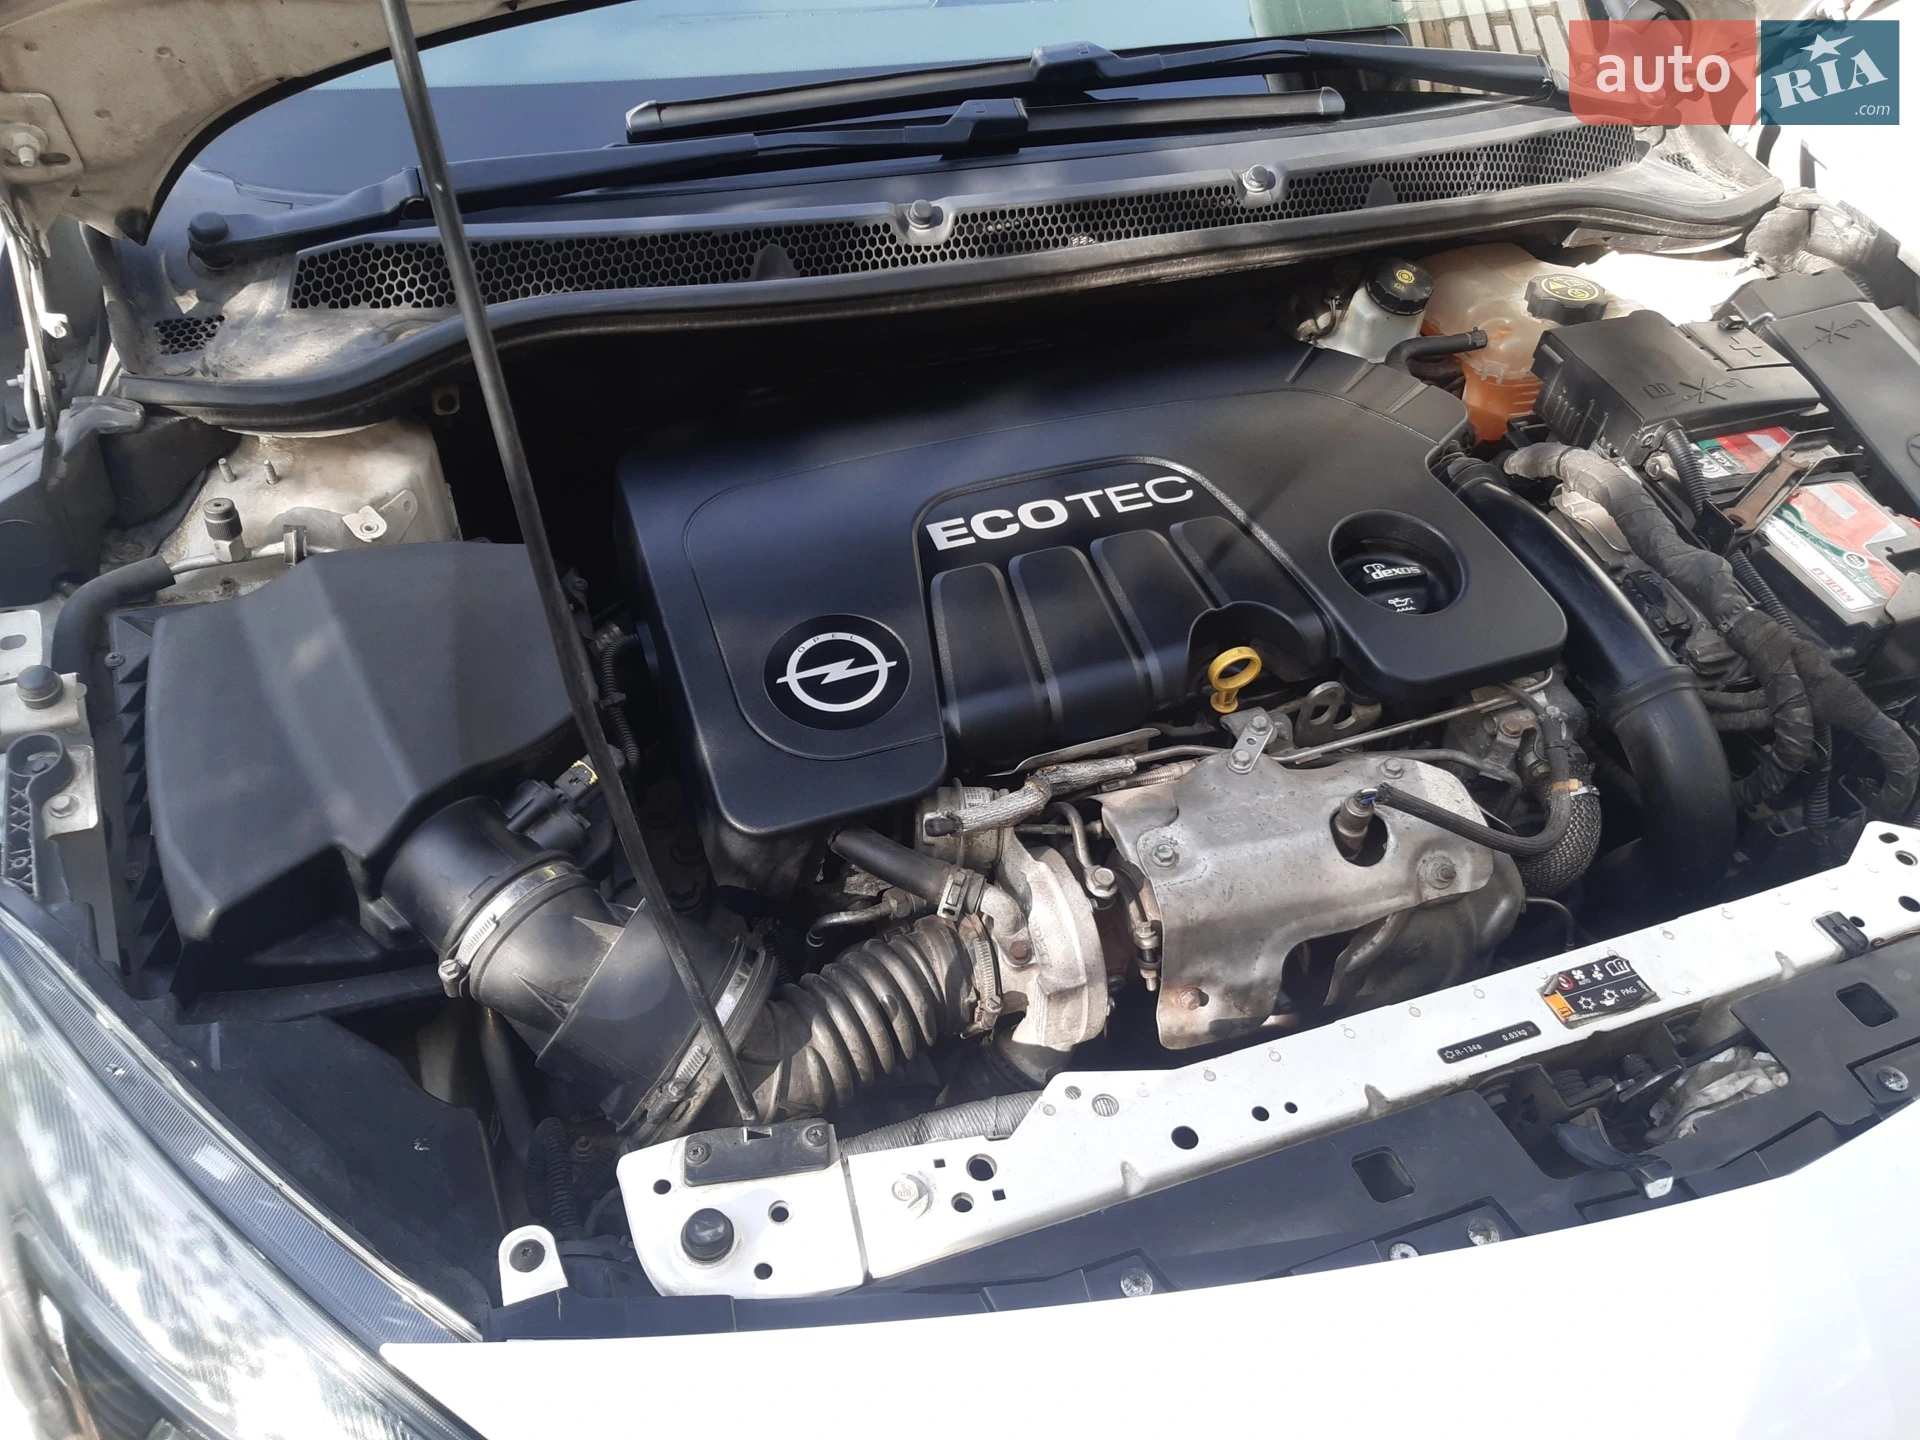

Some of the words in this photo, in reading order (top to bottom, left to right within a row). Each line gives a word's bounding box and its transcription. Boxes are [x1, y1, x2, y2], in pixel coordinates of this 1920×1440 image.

[926, 475, 1194, 551] ECOTEC
[1371, 566, 1421, 580] dexos
[797, 633, 856, 653] OPEL
[1578, 977, 1592, 986] AUTO
[1620, 985, 1638, 996] PAG
